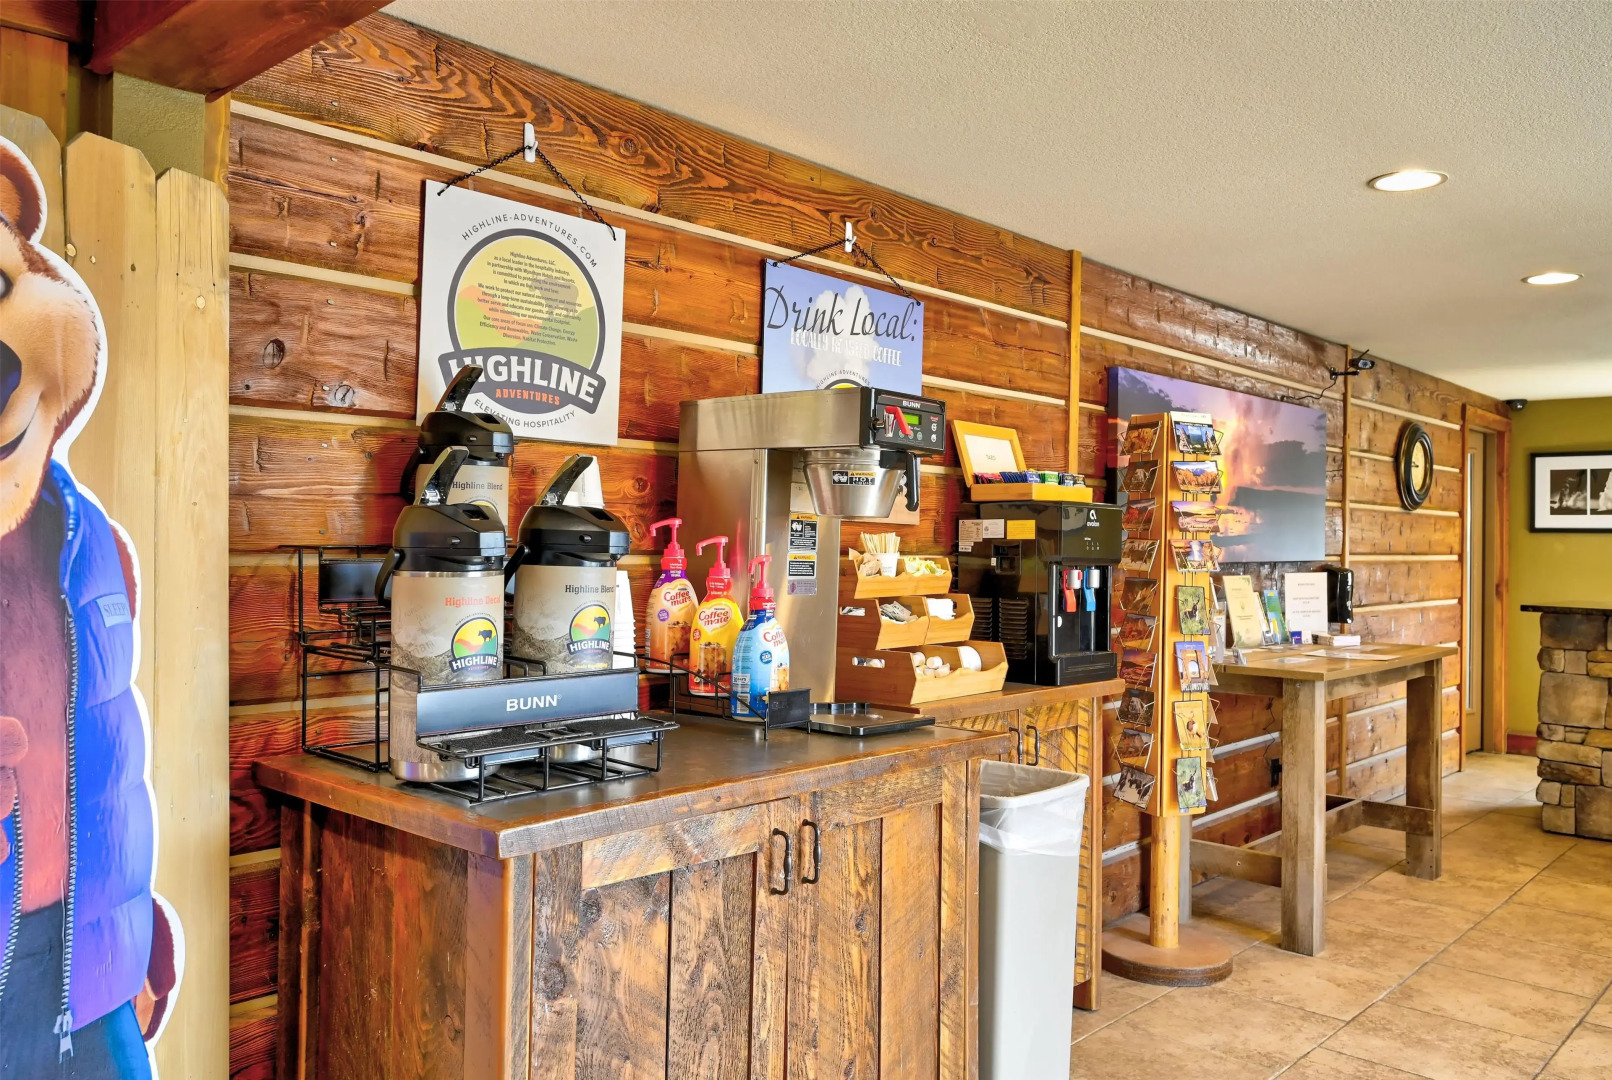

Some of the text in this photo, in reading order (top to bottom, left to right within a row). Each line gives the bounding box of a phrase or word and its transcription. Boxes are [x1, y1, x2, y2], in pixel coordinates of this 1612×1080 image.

[462, 213, 598, 268] HIGHLINE-ADVENTURES.COM
[765, 284, 917, 341] Drink Local:
[790, 327, 828, 351] LOCALLY
[873, 345, 903, 367] COFFEE
[495, 388, 561, 406] ADVENTURES
[902, 400, 921, 409] BUNN
[474, 398, 576, 428] ELEVATING HOSPITALITY
[452, 481, 485, 490] Highline
[565, 585, 599, 594] Highline
[445, 596, 483, 608] Highline
[664, 590, 690, 602] Coffee
[671, 596, 692, 606] mate
[698, 610, 729, 621] Coffee
[704, 616, 729, 626] mate
[570, 641, 610, 653] HIGHLINE
[451, 655, 498, 670] HIGHLINE
[506, 694, 558, 712] BUNN
